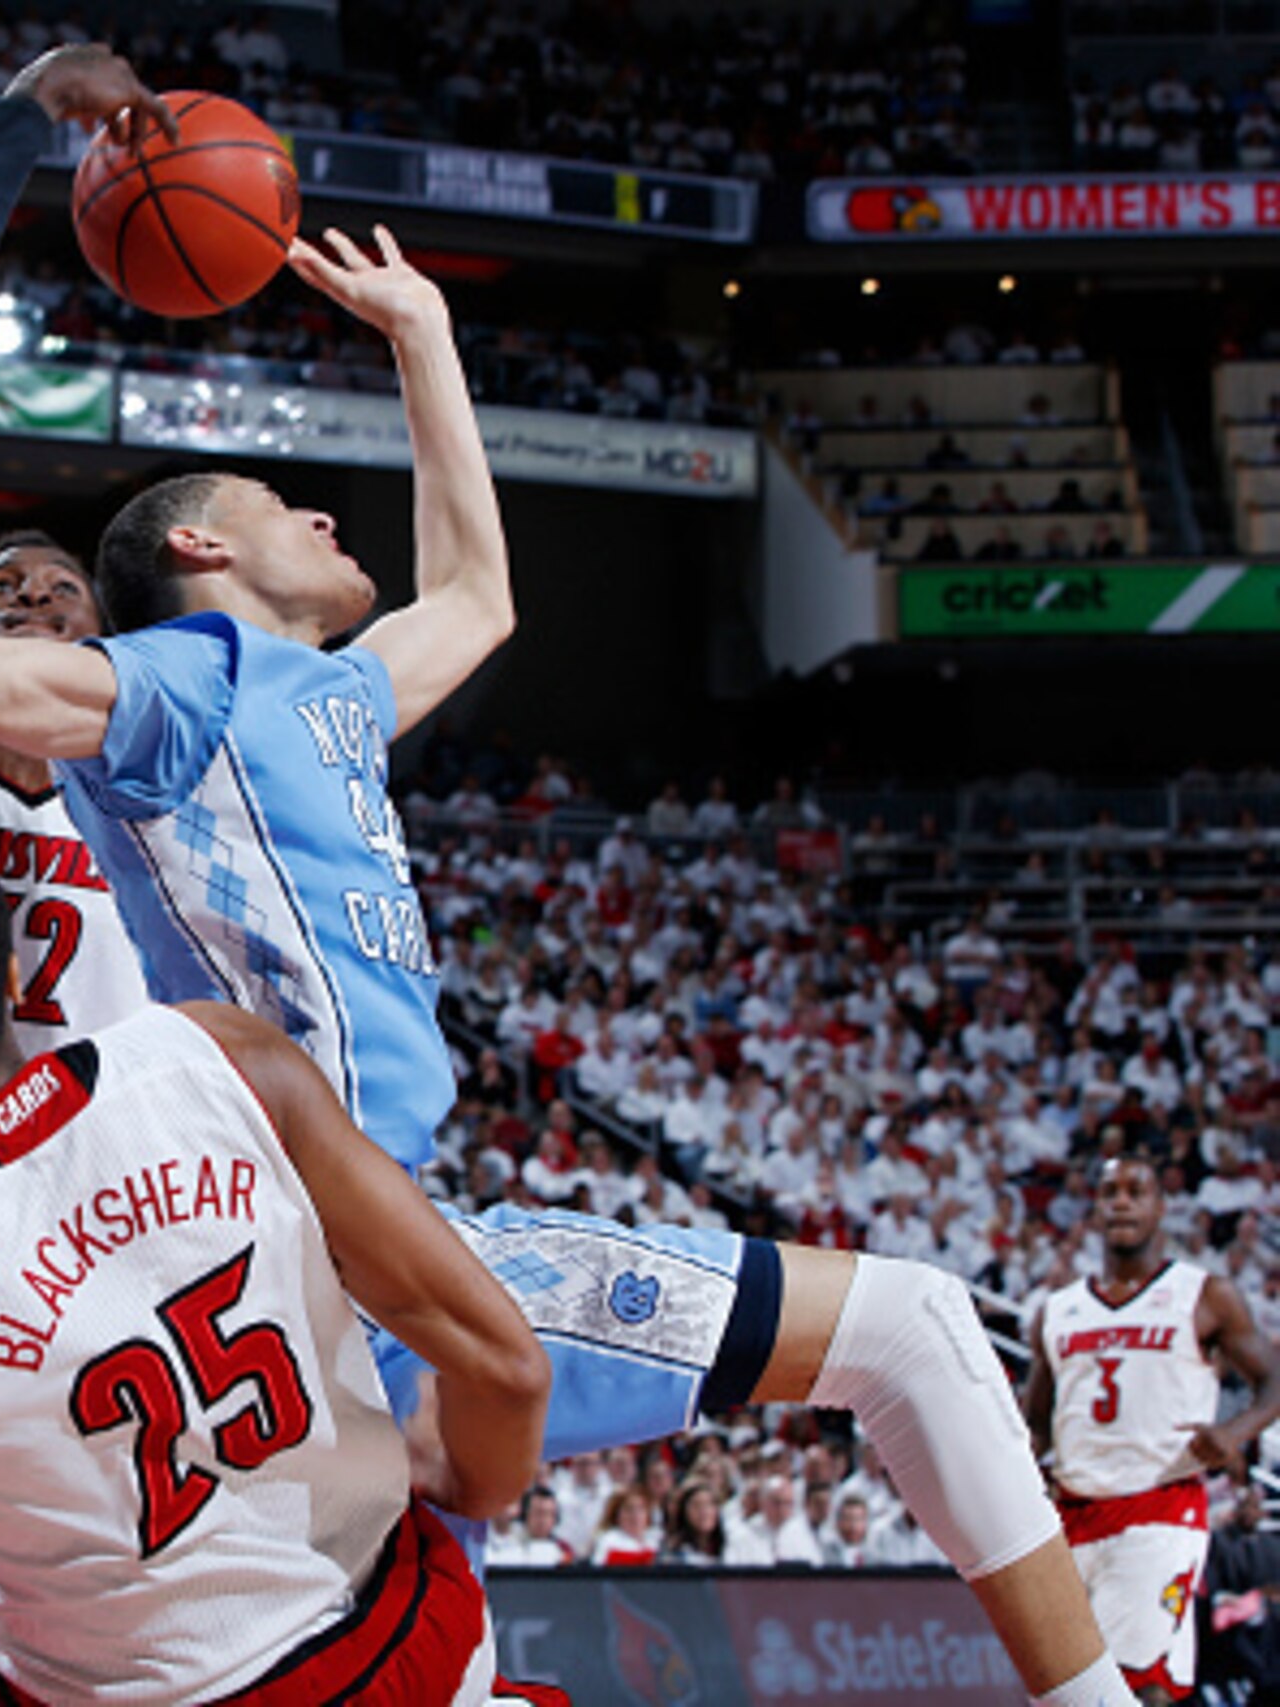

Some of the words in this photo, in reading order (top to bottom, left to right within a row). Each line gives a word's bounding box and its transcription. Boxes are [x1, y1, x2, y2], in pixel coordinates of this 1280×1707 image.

[966, 181, 1232, 231] WOMEN'S
[646, 445, 732, 484] MD2U
[943, 571, 1107, 614] cricket
[1057, 1325, 1177, 1359] LOUISVILLE
[70, 1242, 312, 1560] 25
[1091, 1356, 1124, 1424] 3
[813, 1619, 930, 1692] State
